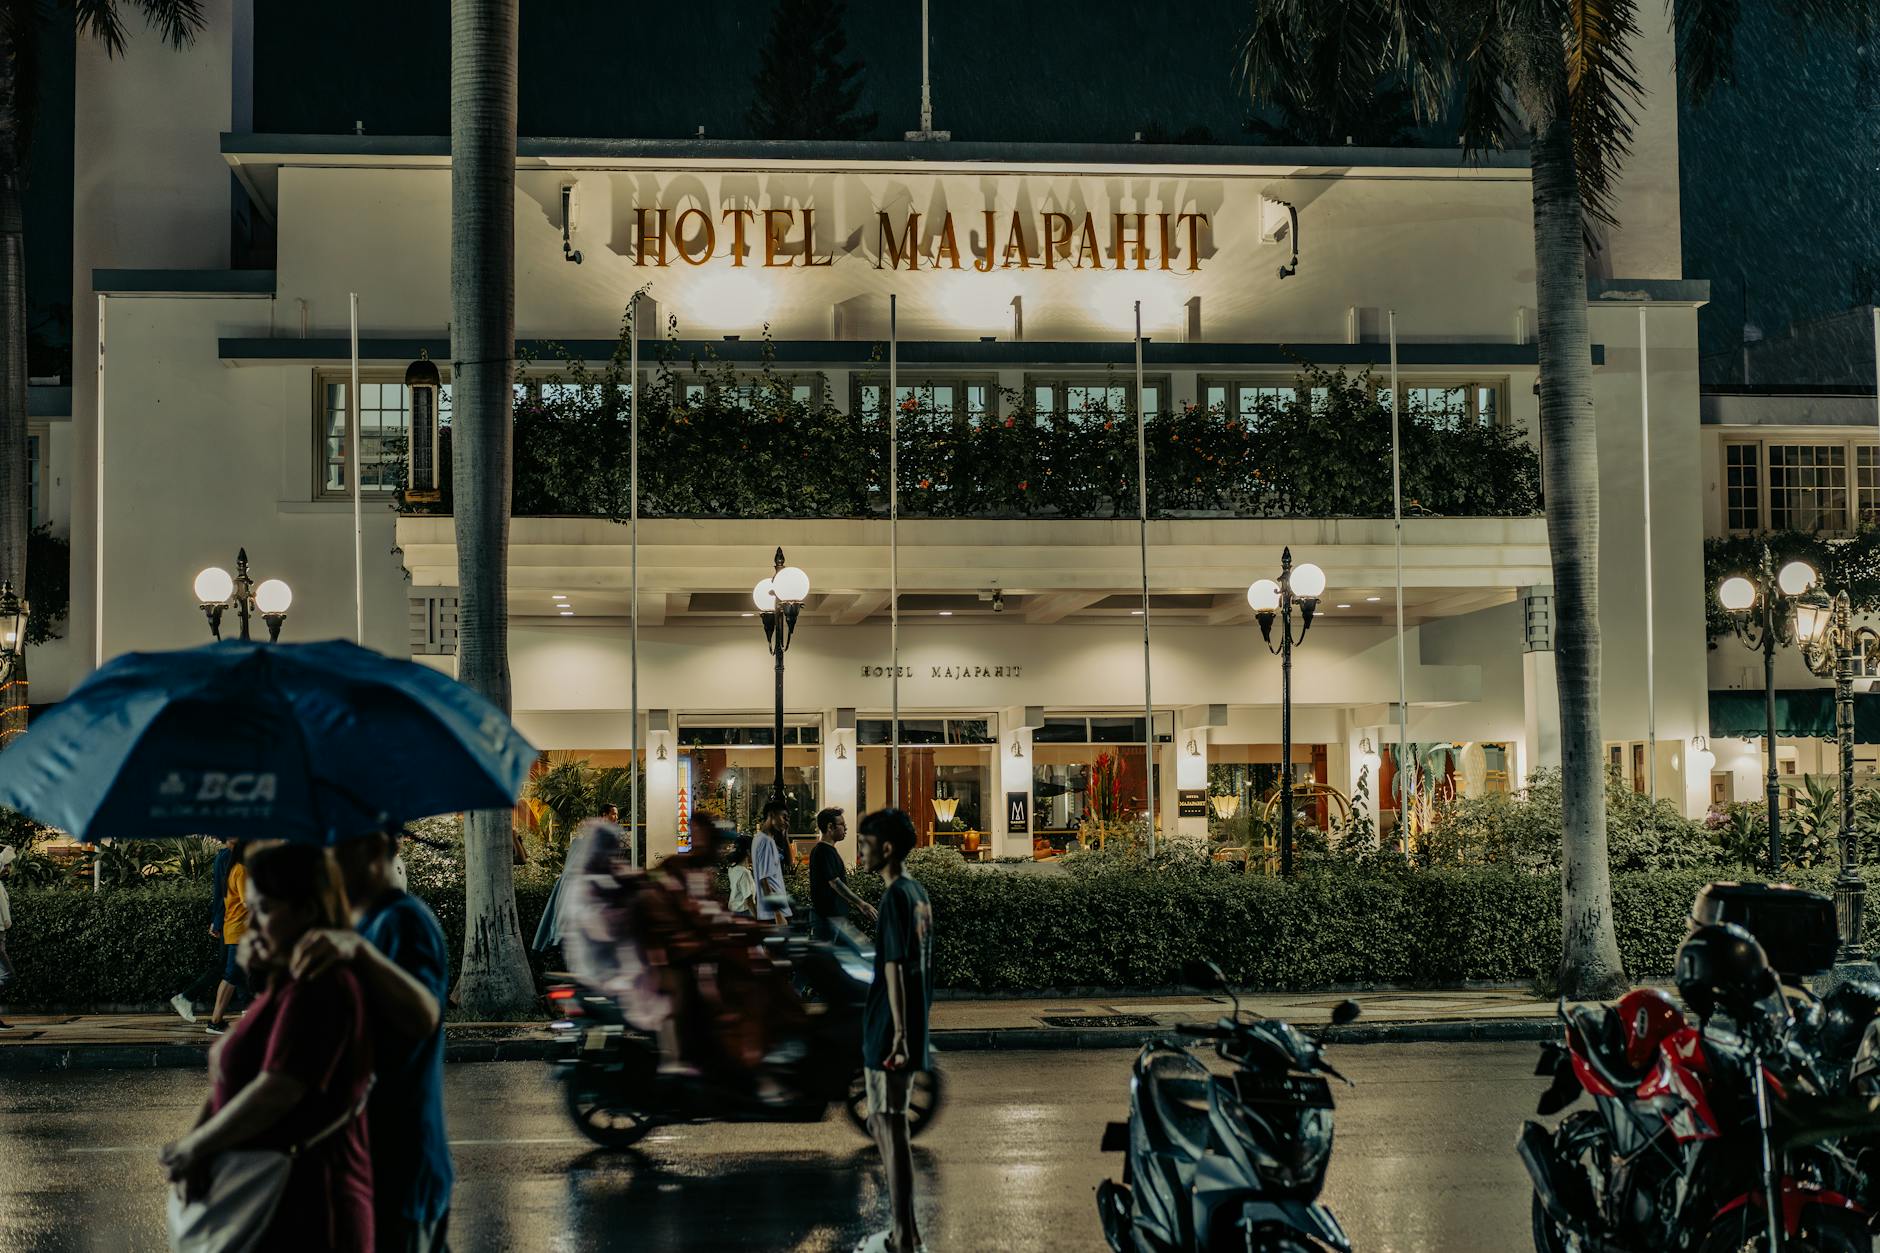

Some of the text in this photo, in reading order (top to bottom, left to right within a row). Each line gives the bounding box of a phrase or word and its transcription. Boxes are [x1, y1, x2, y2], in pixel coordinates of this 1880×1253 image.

[633, 208, 1209, 272] HOTEL MAJAPAHIT
[861, 666, 1022, 679] HOTEL MAJAPAHIT
[197, 773, 276, 801] BCA
